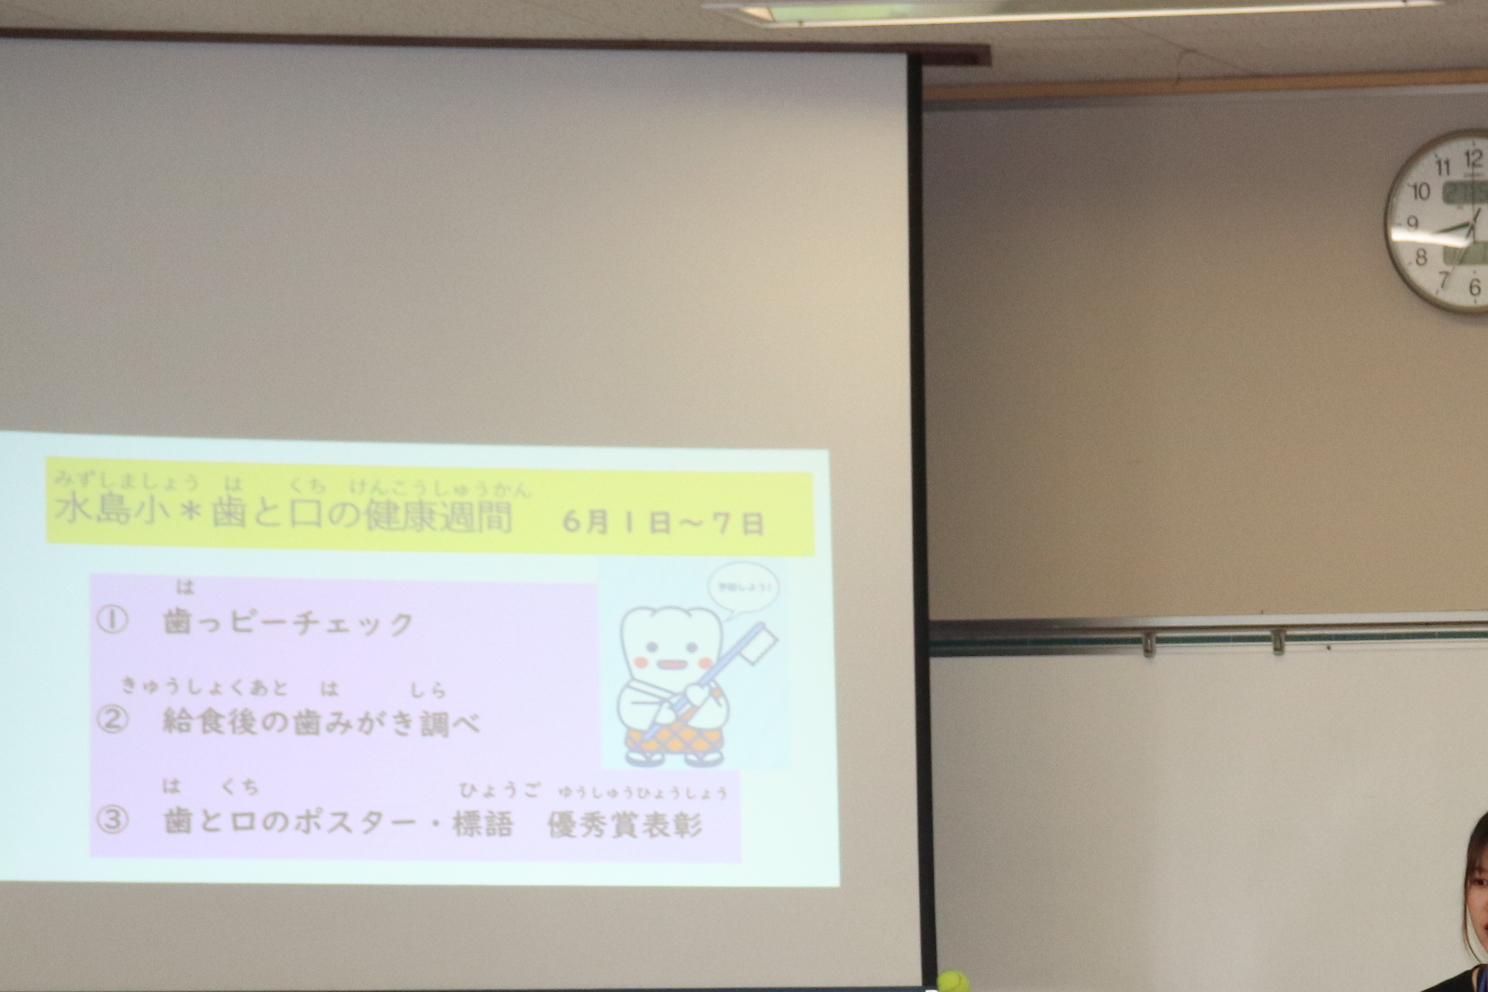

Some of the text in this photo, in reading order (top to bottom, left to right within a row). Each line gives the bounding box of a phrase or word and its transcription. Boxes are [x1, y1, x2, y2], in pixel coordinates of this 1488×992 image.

[1436, 159, 1450, 176] 11
[1465, 149, 1483, 168] 12
[1411, 182, 1431, 200] 10
[1407, 215, 1419, 230] 9
[1415, 248, 1427, 266] 8
[1438, 271, 1450, 289] 7
[1469, 278, 1481, 296] 6
[54, 469, 532, 499] みずしましょう は くち けんこうしゅうかん
[176, 578, 196, 596] は
[163, 606, 414, 637] 歯っピーチェック
[121, 675, 447, 699] きゅうしょくあと は しら
[162, 706, 481, 739] 給食後の歯みがき調べ
[162, 777, 181, 795] は
[221, 777, 259, 796] くち
[459, 781, 542, 799] ひょうご
[547, 810, 703, 840] 優秀賞表彰
